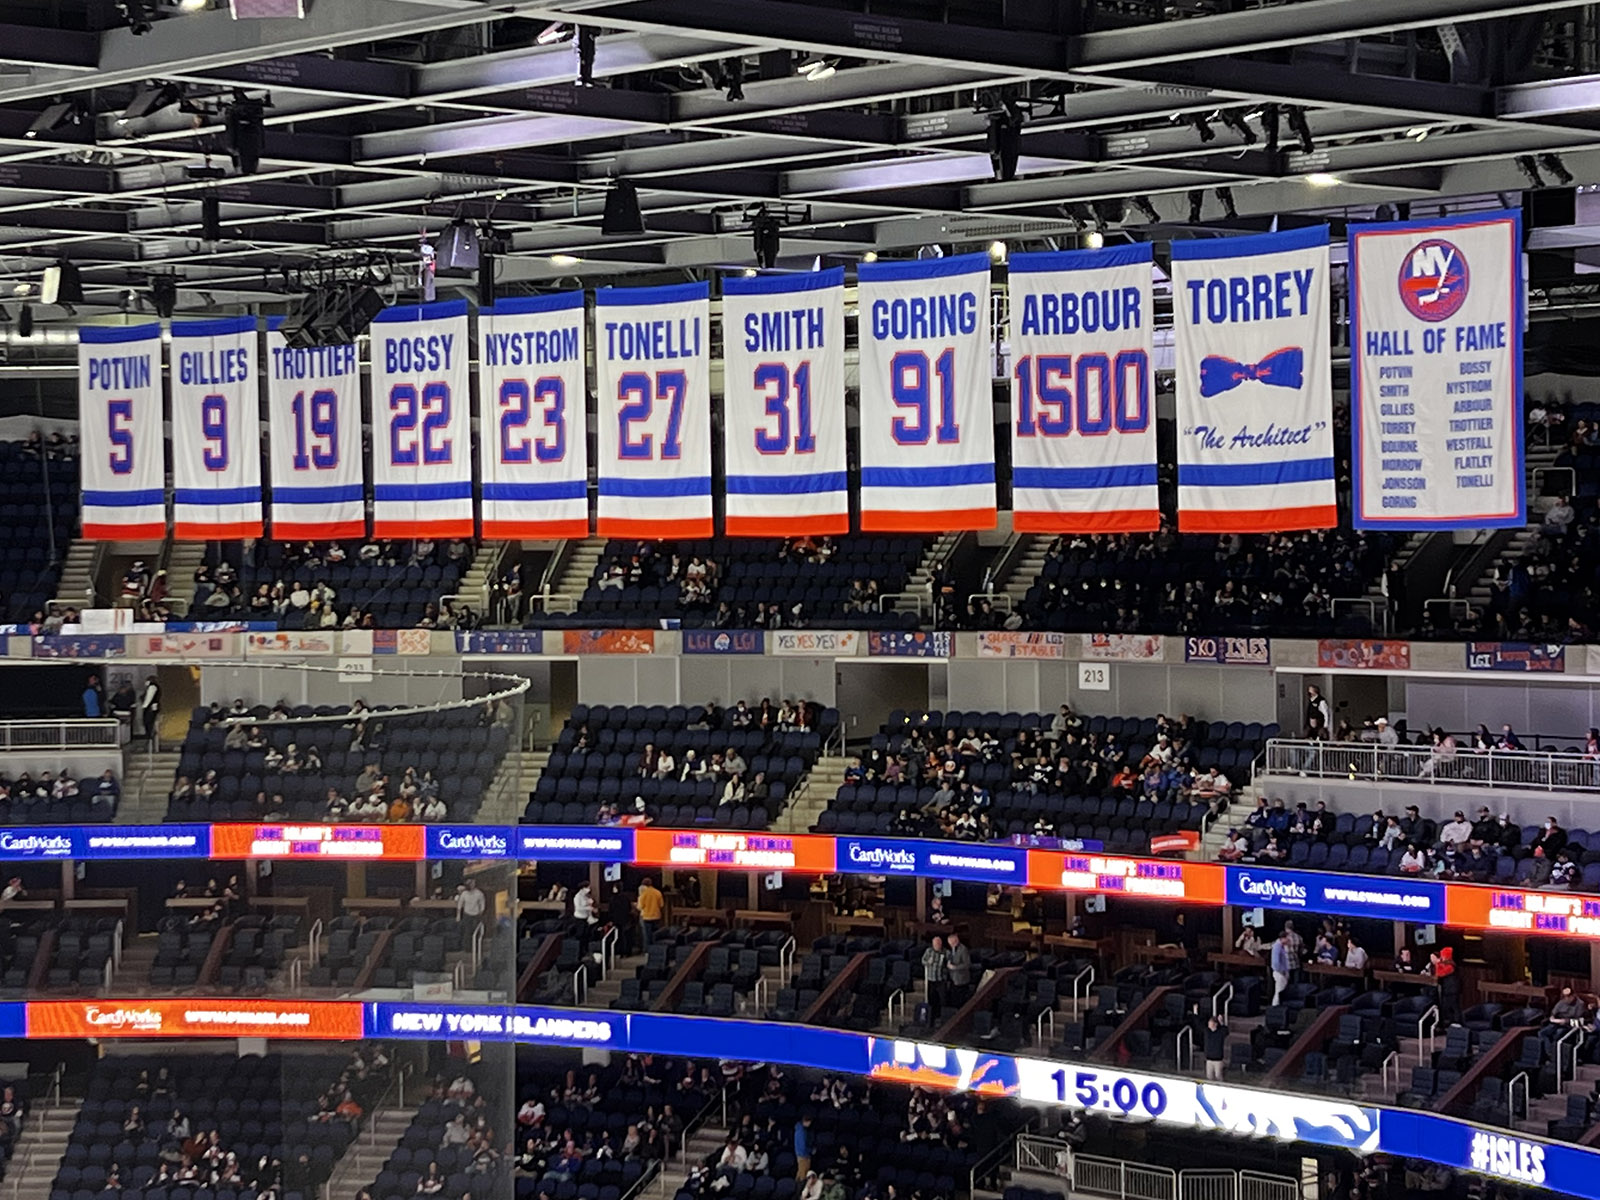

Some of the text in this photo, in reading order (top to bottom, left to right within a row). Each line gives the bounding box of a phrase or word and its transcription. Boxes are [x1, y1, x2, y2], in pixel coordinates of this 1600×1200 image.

[1021, 286, 1141, 336] ARBOUR
[1186, 268, 1315, 325] TORREY
[744, 307, 825, 352] SMITH
[872, 291, 976, 341] GORING
[385, 334, 453, 374] BOSSY
[485, 326, 579, 366] NYSTROM
[605, 317, 700, 361] TONELLI
[1367, 321, 1506, 357] HALL OF FAME
[89, 354, 150, 391] POTVIN
[180, 348, 248, 386] GILLIES
[272, 343, 355, 380] TROTTIER
[1380, 366, 1413, 379] POTVIN
[1460, 361, 1492, 375] BOSSY
[890, 347, 960, 446] 91
[1014, 348, 1150, 438] 1500
[1380, 384, 1409, 397] SMITH
[1447, 379, 1492, 394] NYSTROM
[389, 380, 453, 466] 22
[500, 376, 566, 464] 23
[617, 369, 688, 461] 27
[754, 361, 817, 455] 31
[1381, 403, 1415, 416] GILLIES
[1454, 398, 1493, 413] ARBOUR
[108, 399, 134, 475] 5
[201, 394, 229, 472] 9
[292, 388, 338, 471] 19
[1381, 421, 1416, 434] TORREY
[1449, 418, 1493, 432] TROTTIER
[1381, 440, 1418, 453] BOURNE
[1446, 437, 1493, 451] WESTFALL
[1382, 459, 1422, 471] MORROW
[1455, 455, 1493, 470] FLATLEY
[1382, 477, 1426, 490] JONSSON
[1456, 475, 1493, 488] TONELLI
[1382, 496, 1417, 509] GORING
[778, 634, 796, 649] YES
[797, 634, 815, 649] YES
[1225, 637, 1268, 658] ISLES
[1084, 670, 1104, 683] 213
[850, 845, 915, 864] CardWorks
[1240, 876, 1306, 898] CardWorks
[393, 1011, 611, 1041] NEW YORK ISLANDERS
[1050, 1068, 1168, 1117] 15:00
[1471, 1132, 1545, 1183] #ISLES
